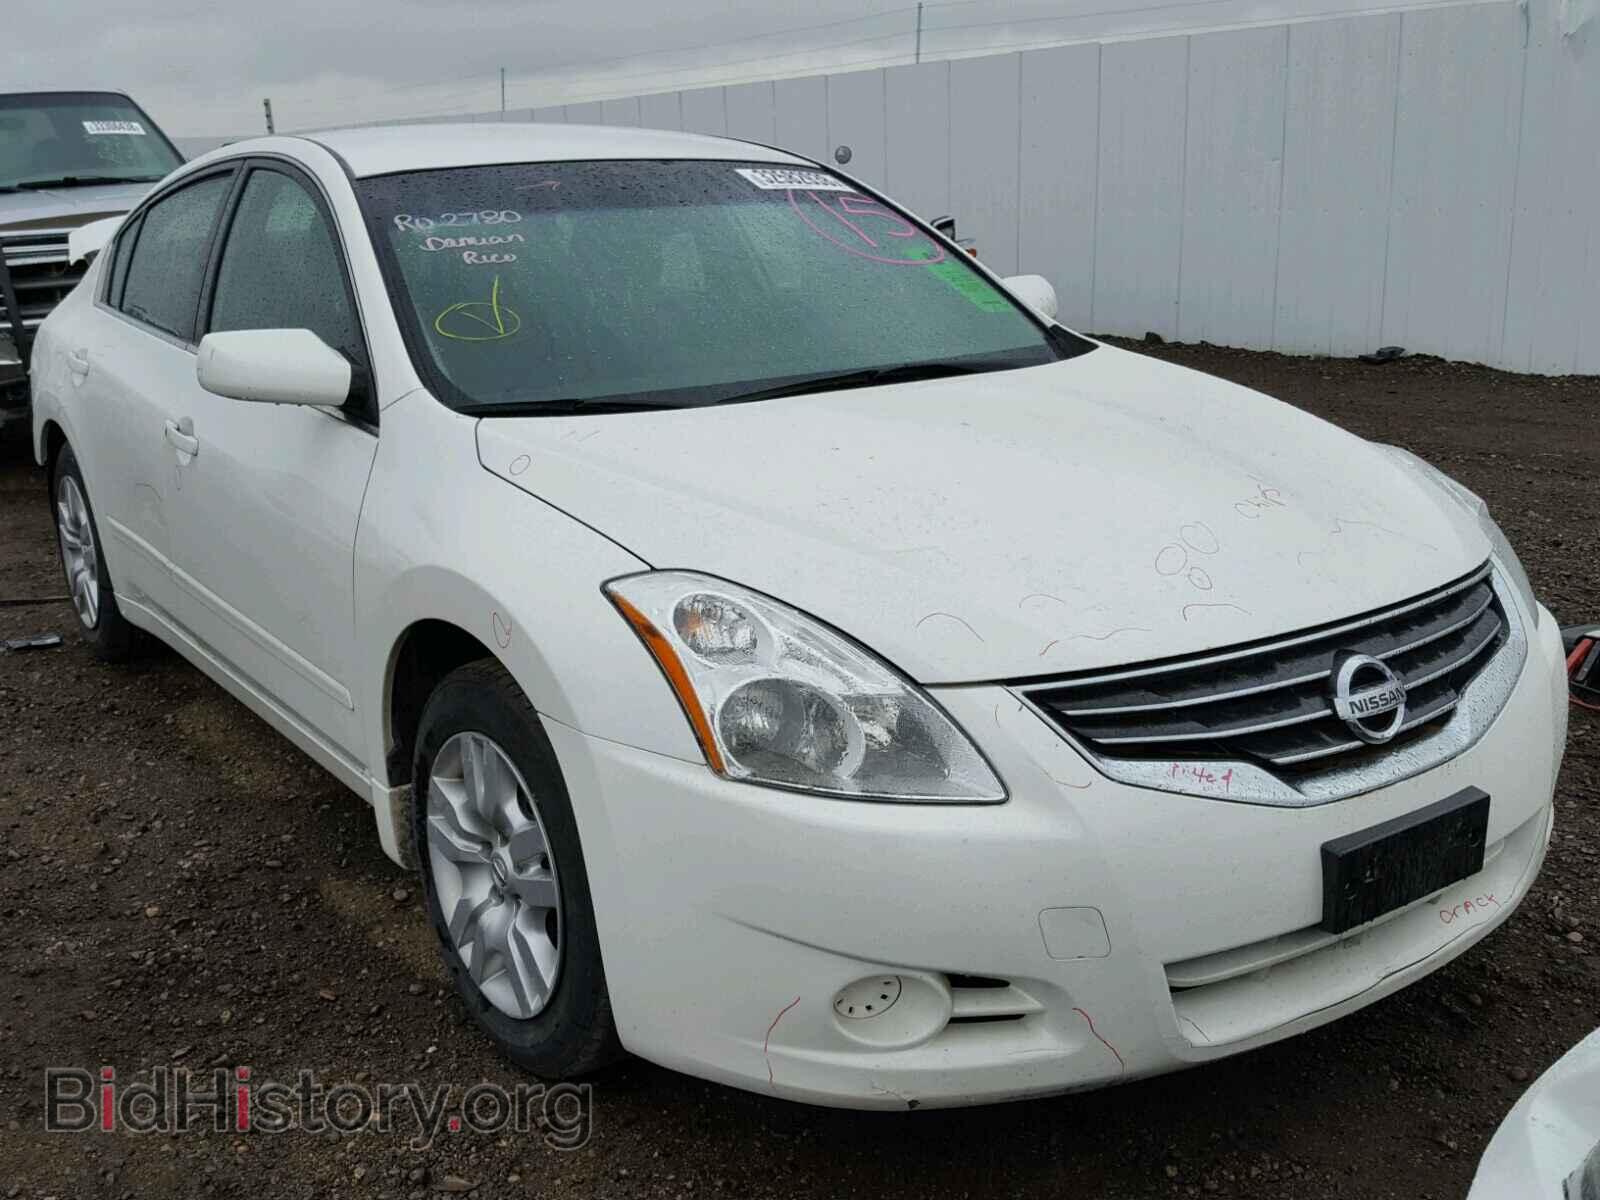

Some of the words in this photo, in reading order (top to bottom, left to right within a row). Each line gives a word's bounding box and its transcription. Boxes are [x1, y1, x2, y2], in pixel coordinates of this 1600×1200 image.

[440, 209, 523, 227] 2780
[462, 250, 518, 265] Rico
[1349, 684, 1406, 715] NISSAN
